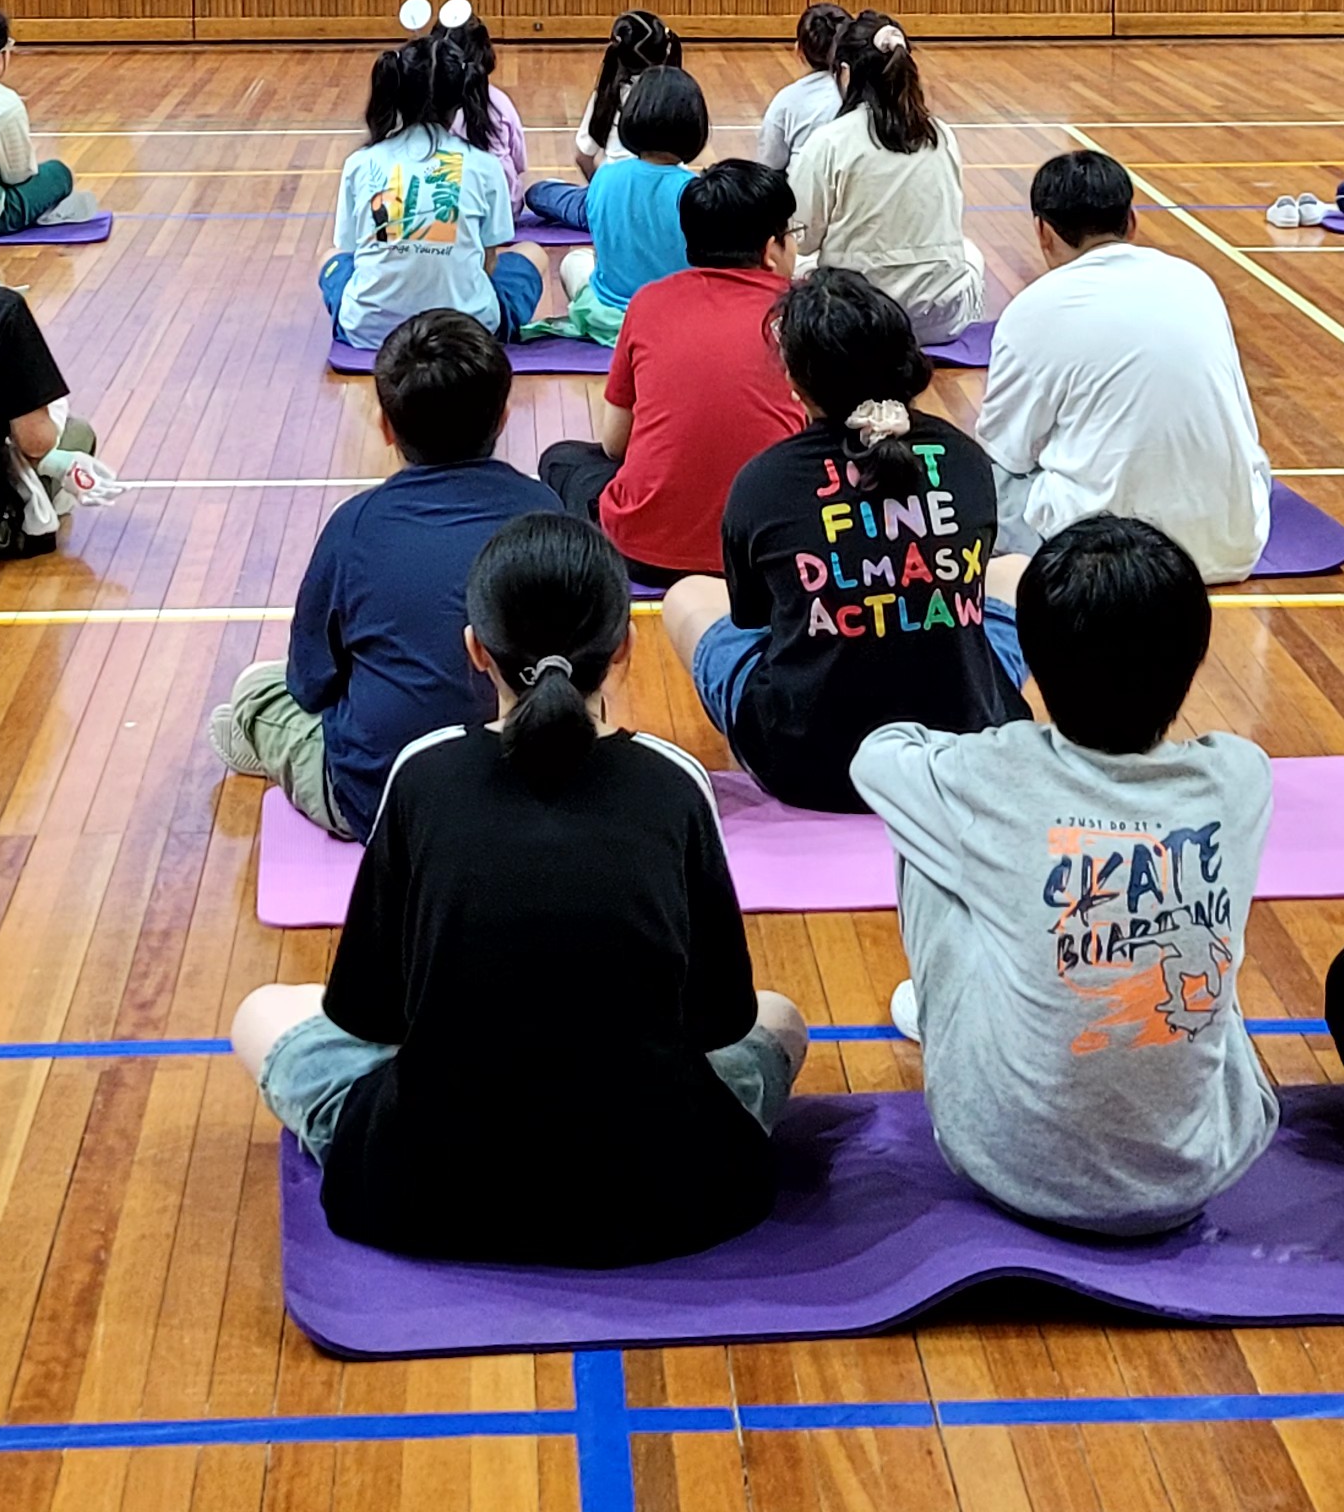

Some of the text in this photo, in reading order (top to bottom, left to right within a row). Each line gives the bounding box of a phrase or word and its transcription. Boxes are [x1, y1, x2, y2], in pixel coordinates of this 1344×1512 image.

[821, 490, 959, 543] FINE
[795, 538, 983, 592] DLMASX
[808, 583, 982, 638] ACTLAW
